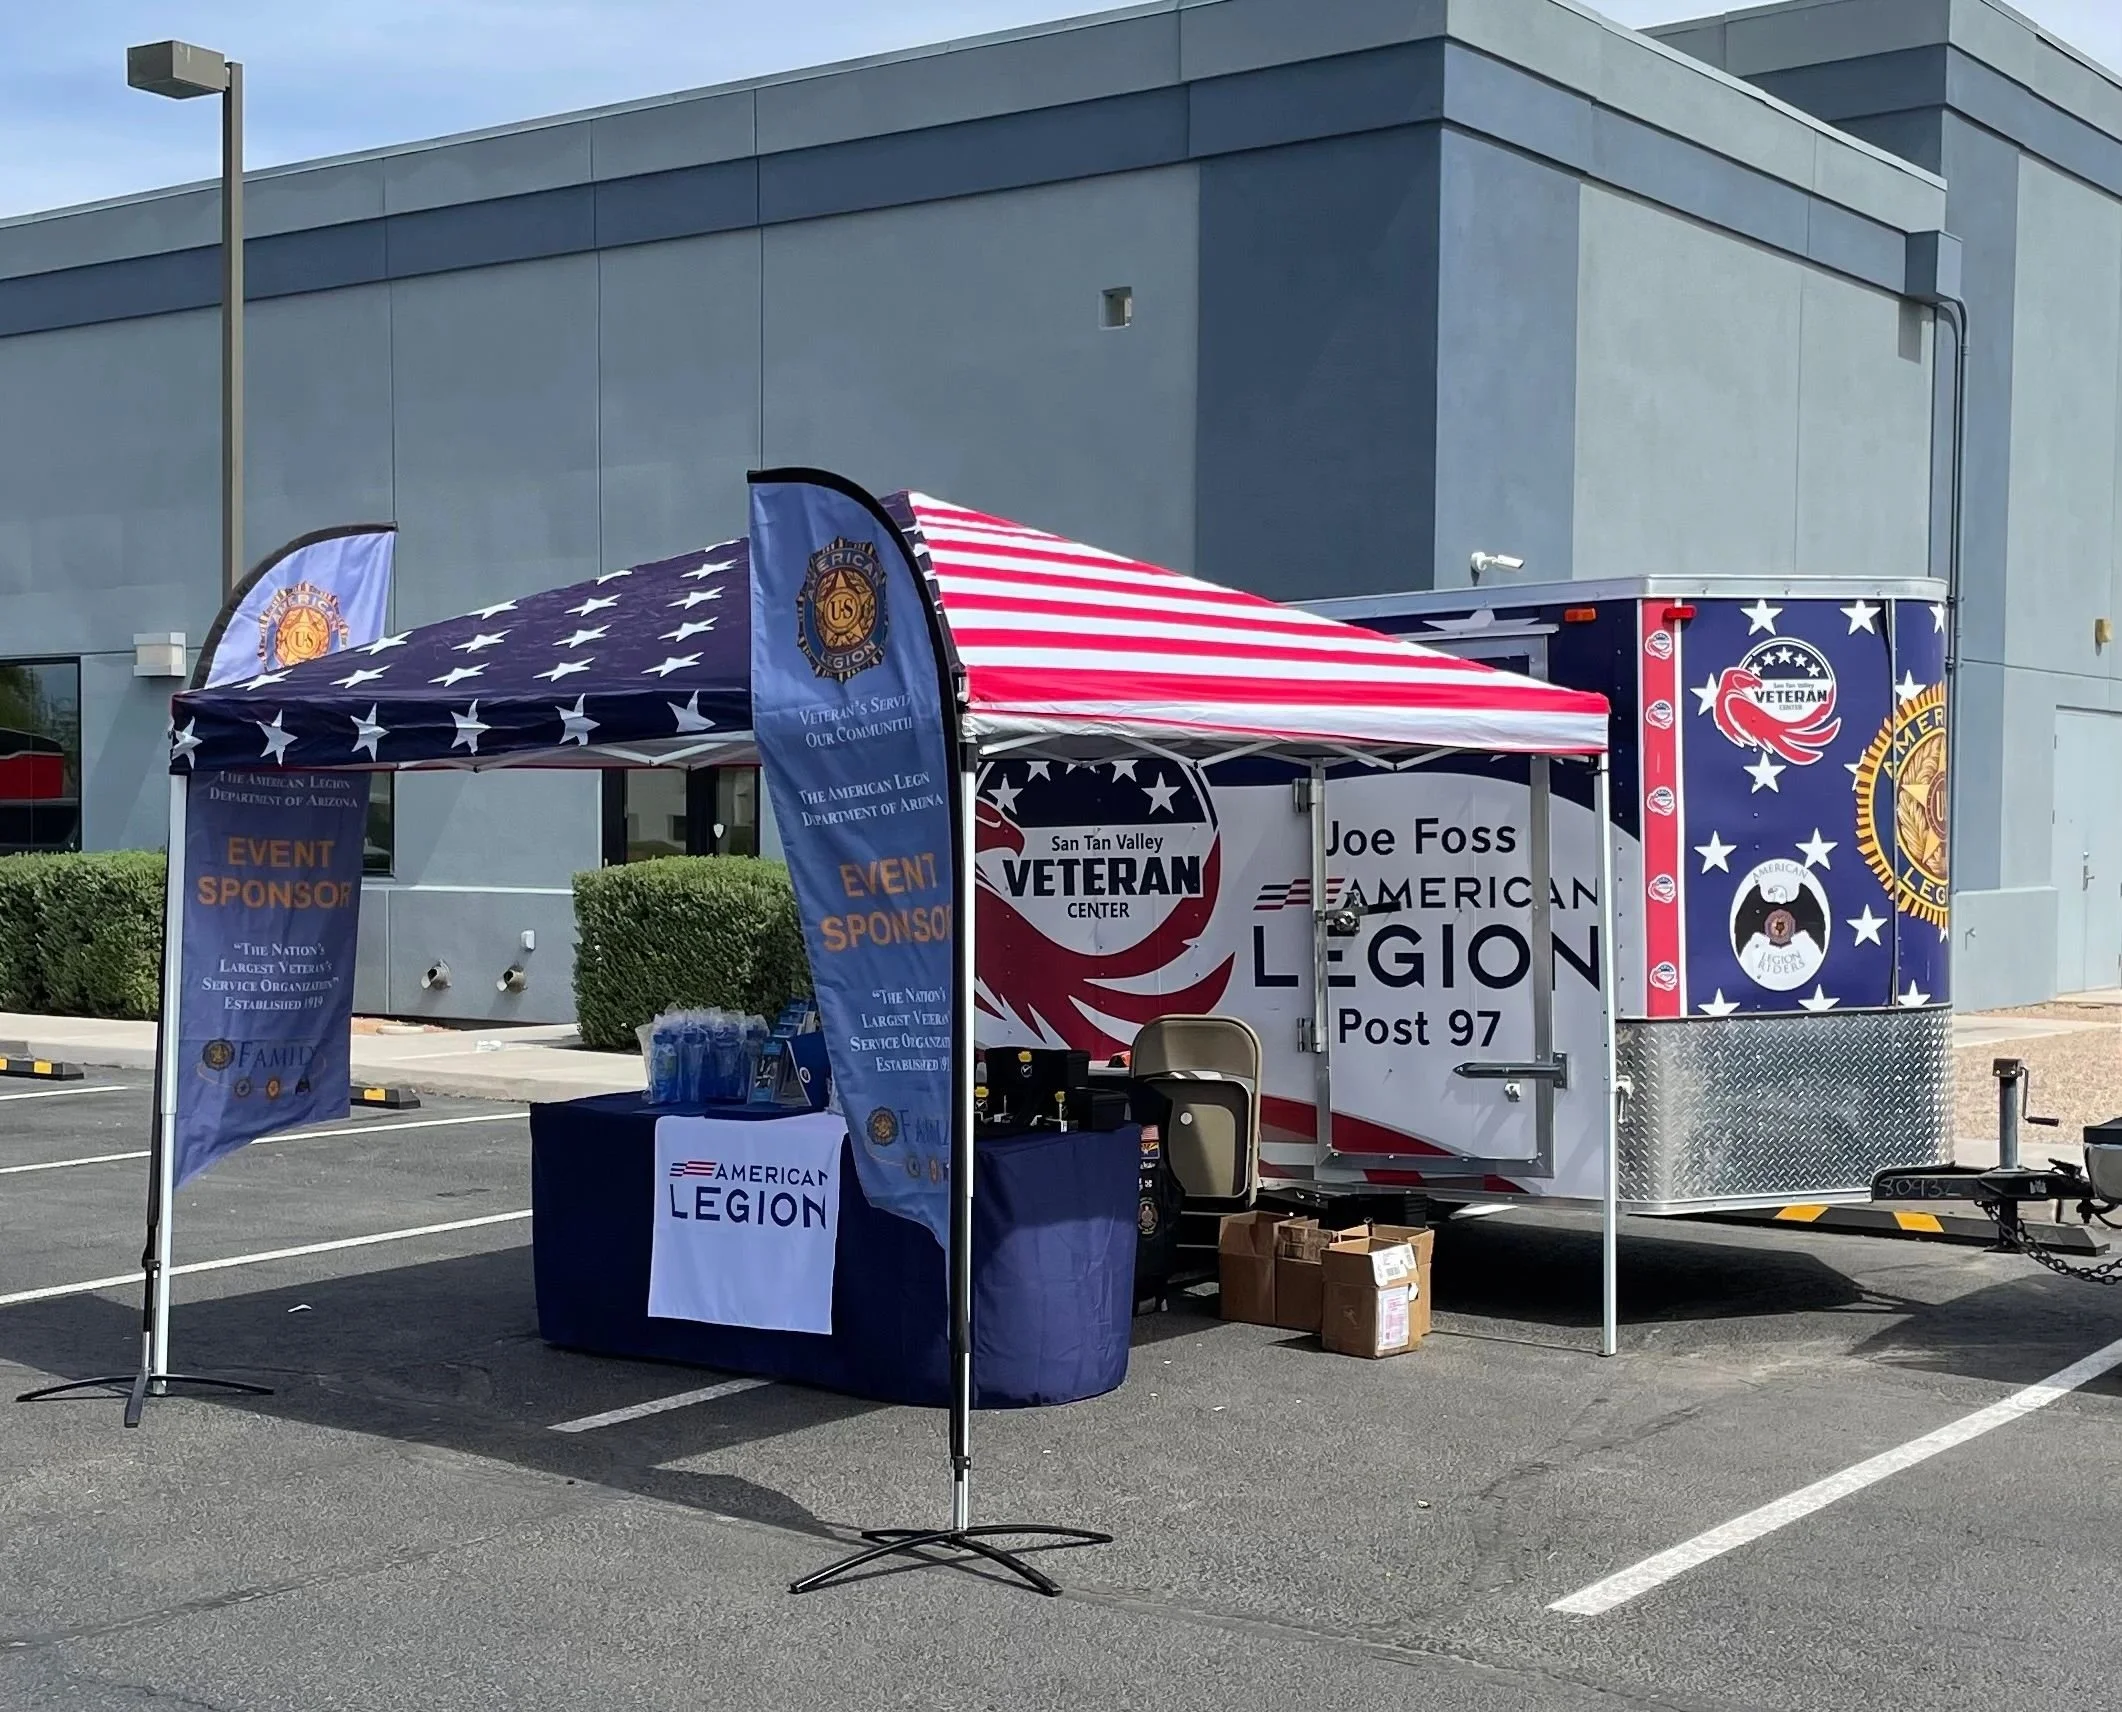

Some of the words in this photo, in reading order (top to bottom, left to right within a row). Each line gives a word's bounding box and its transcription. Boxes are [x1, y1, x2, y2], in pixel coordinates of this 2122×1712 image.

[820, 640, 877, 669] LEGION
[1754, 690, 1828, 704] VETERAN
[805, 731, 836, 748] OUR
[219, 770, 244, 785] THE
[209, 787, 281, 806] DEPARTMENT
[285, 795, 304, 807] OF
[306, 793, 359, 809] ARIZONA
[798, 789, 827, 805] THE
[828, 779, 893, 802] AMERICAN
[880, 802, 897, 816] OF
[1051, 835, 1080, 852] San
[1083, 834, 1112, 852] Tan
[1115, 832, 1164, 854] Valley
[1326, 820, 1396, 857] Joe
[1414, 817, 1517, 855] Foss
[227, 836, 336, 868] EVENT
[838, 851, 938, 898] EVENT
[1002, 855, 1201, 898] VETERAN
[197, 875, 352, 909] SPONSOR
[1346, 875, 1598, 910] AMERICAN
[1067, 902, 1130, 920] CENTER
[219, 959, 275, 974] LARGEST
[1252, 923, 1600, 992] LEGION
[1758, 960, 1806, 974] RIDERS
[201, 976, 258, 992] SERVICE
[223, 997, 302, 1011] ESTABLISHED
[1338, 1007, 1431, 1046] Post
[1448, 1009, 1501, 1048] 97
[850, 1036, 900, 1052] SERVICE
[714, 1162, 829, 1187] AMERICAN
[669, 1183, 828, 1231] LEGION
